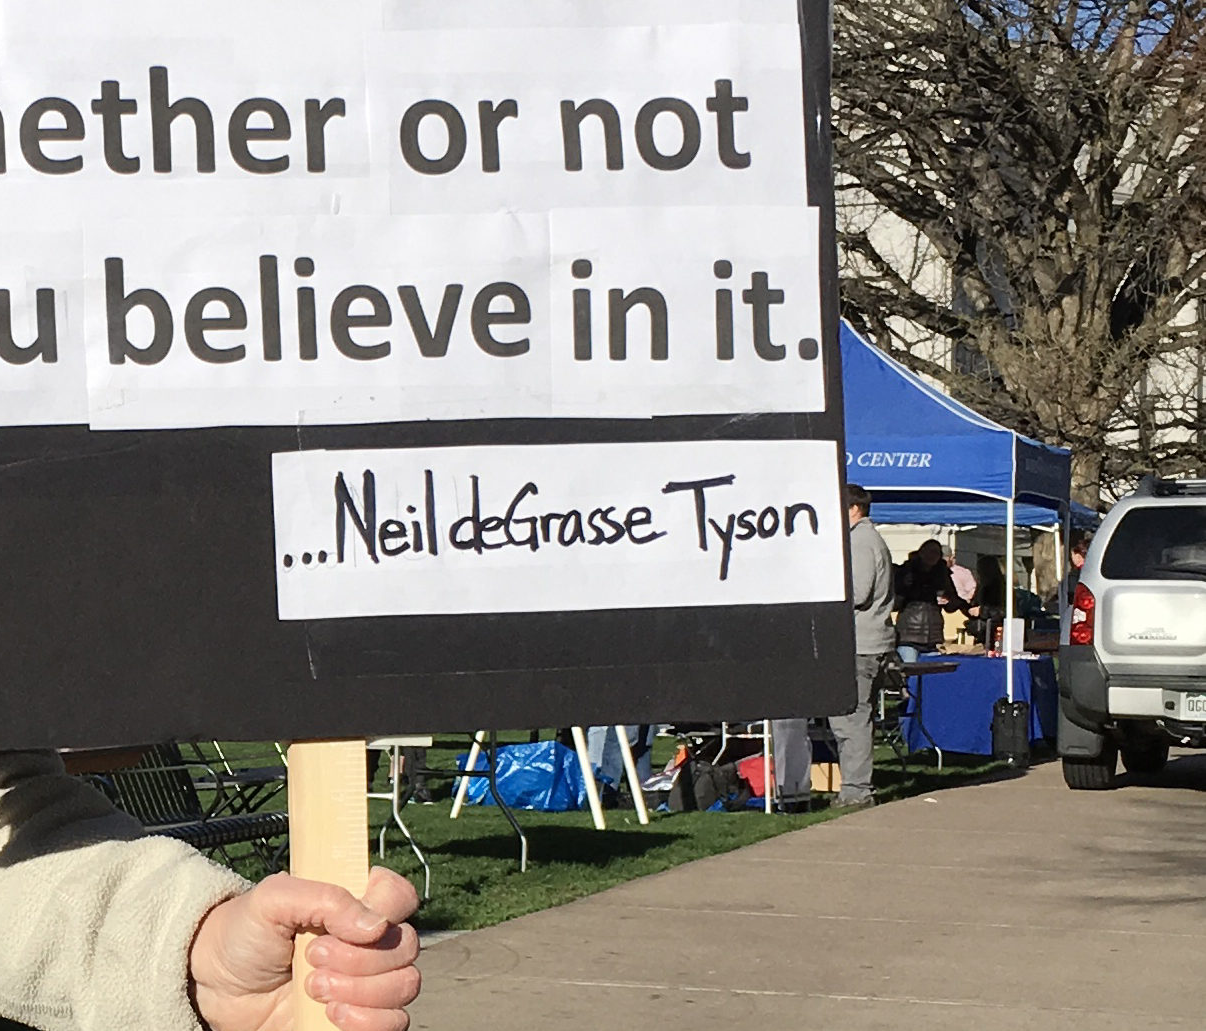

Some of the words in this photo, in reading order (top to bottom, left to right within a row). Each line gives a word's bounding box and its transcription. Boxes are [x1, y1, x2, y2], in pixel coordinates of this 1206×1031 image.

[399, 97, 519, 175] or
[560, 79, 752, 173] not
[104, 254, 532, 366] believe
[571, 258, 669, 362] in
[713, 259, 819, 362] it.
[857, 451, 933, 468] CENTER
[449, 474, 668, 555] deGrasse
[661, 474, 819, 581] Tyson
